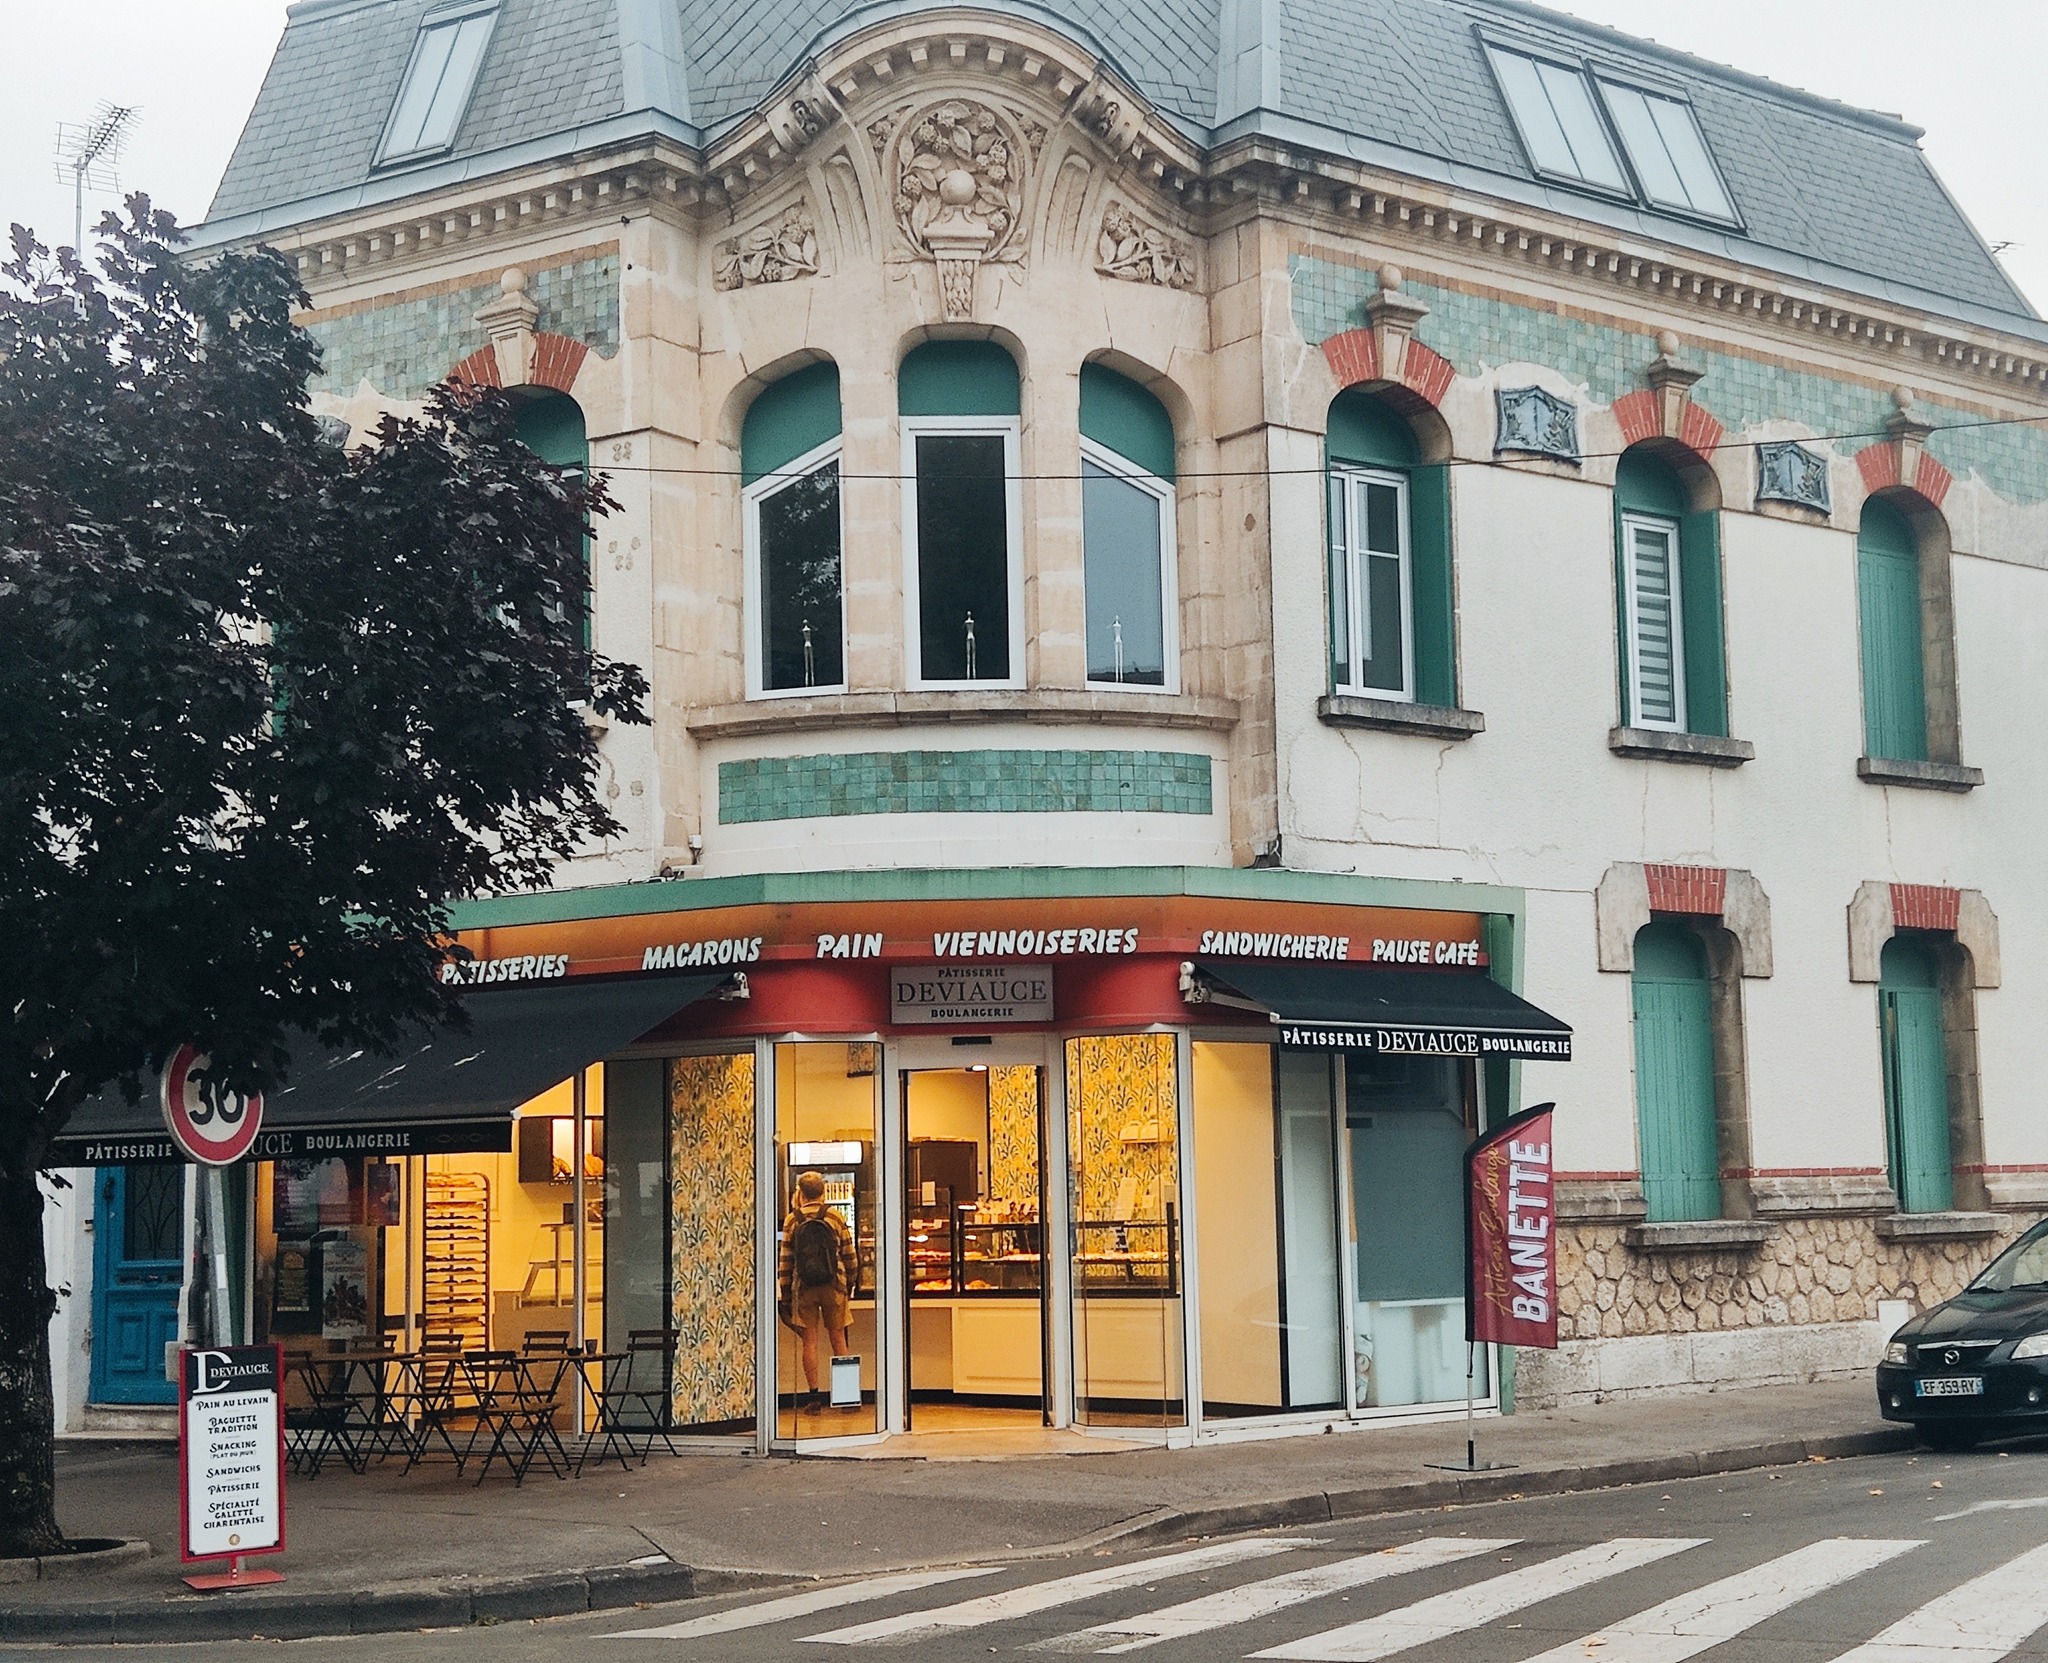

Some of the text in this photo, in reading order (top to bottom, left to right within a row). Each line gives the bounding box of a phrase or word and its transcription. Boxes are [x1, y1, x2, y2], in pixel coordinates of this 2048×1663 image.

[816, 932, 883, 959] PAIN
[933, 927, 1139, 957] VIENNOISERIES
[1200, 929, 1350, 961] SANDWICHERIE
[1372, 938, 1480, 966] PAUSE CAFÉ
[642, 937, 762, 970] MACARONS
[938, 967, 1005, 978] PÂTISSERIE
[896, 980, 1047, 1003] DEVIAUCE
[930, 1007, 1013, 1018] BOULANGERIE
[1282, 1027, 1570, 1054] PÂTISSERIE DEVIAUCE BOULANGERIE
[187, 1068, 245, 1125] 30
[85, 1142, 173, 1160] PÂTISSERIE
[306, 1133, 410, 1150] BOULANGERIE
[1508, 1139, 1549, 1323] BANETTE
[210, 1363, 272, 1378] DEVIAUCE
[237, 1397, 269, 1406] LEVAIN
[208, 1424, 258, 1434] TRADITION
[203, 1516, 265, 1529] CHARENTAISE
[214, 1508, 254, 1519] GALETTE
